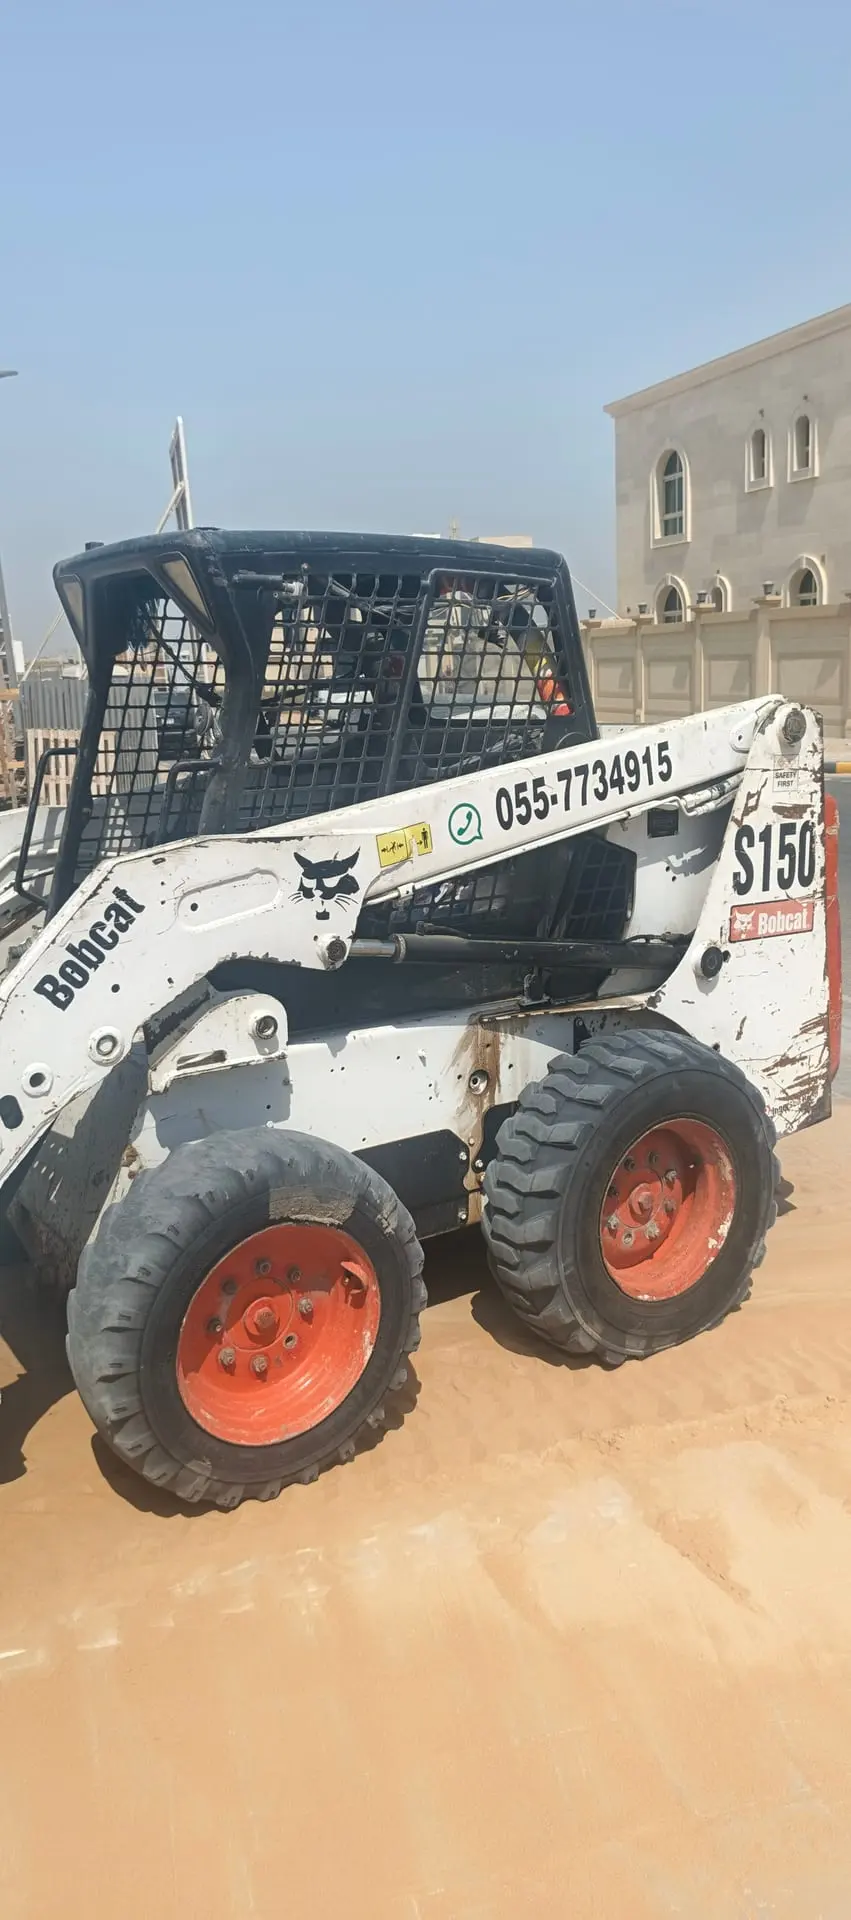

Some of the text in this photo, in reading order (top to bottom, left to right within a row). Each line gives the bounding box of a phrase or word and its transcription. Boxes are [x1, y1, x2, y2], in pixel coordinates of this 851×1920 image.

[495, 741, 673, 830] 055-7734915
[775, 771, 797, 779] SAFETY
[732, 820, 816, 896] S150
[33, 886, 146, 1012] Bobcat
